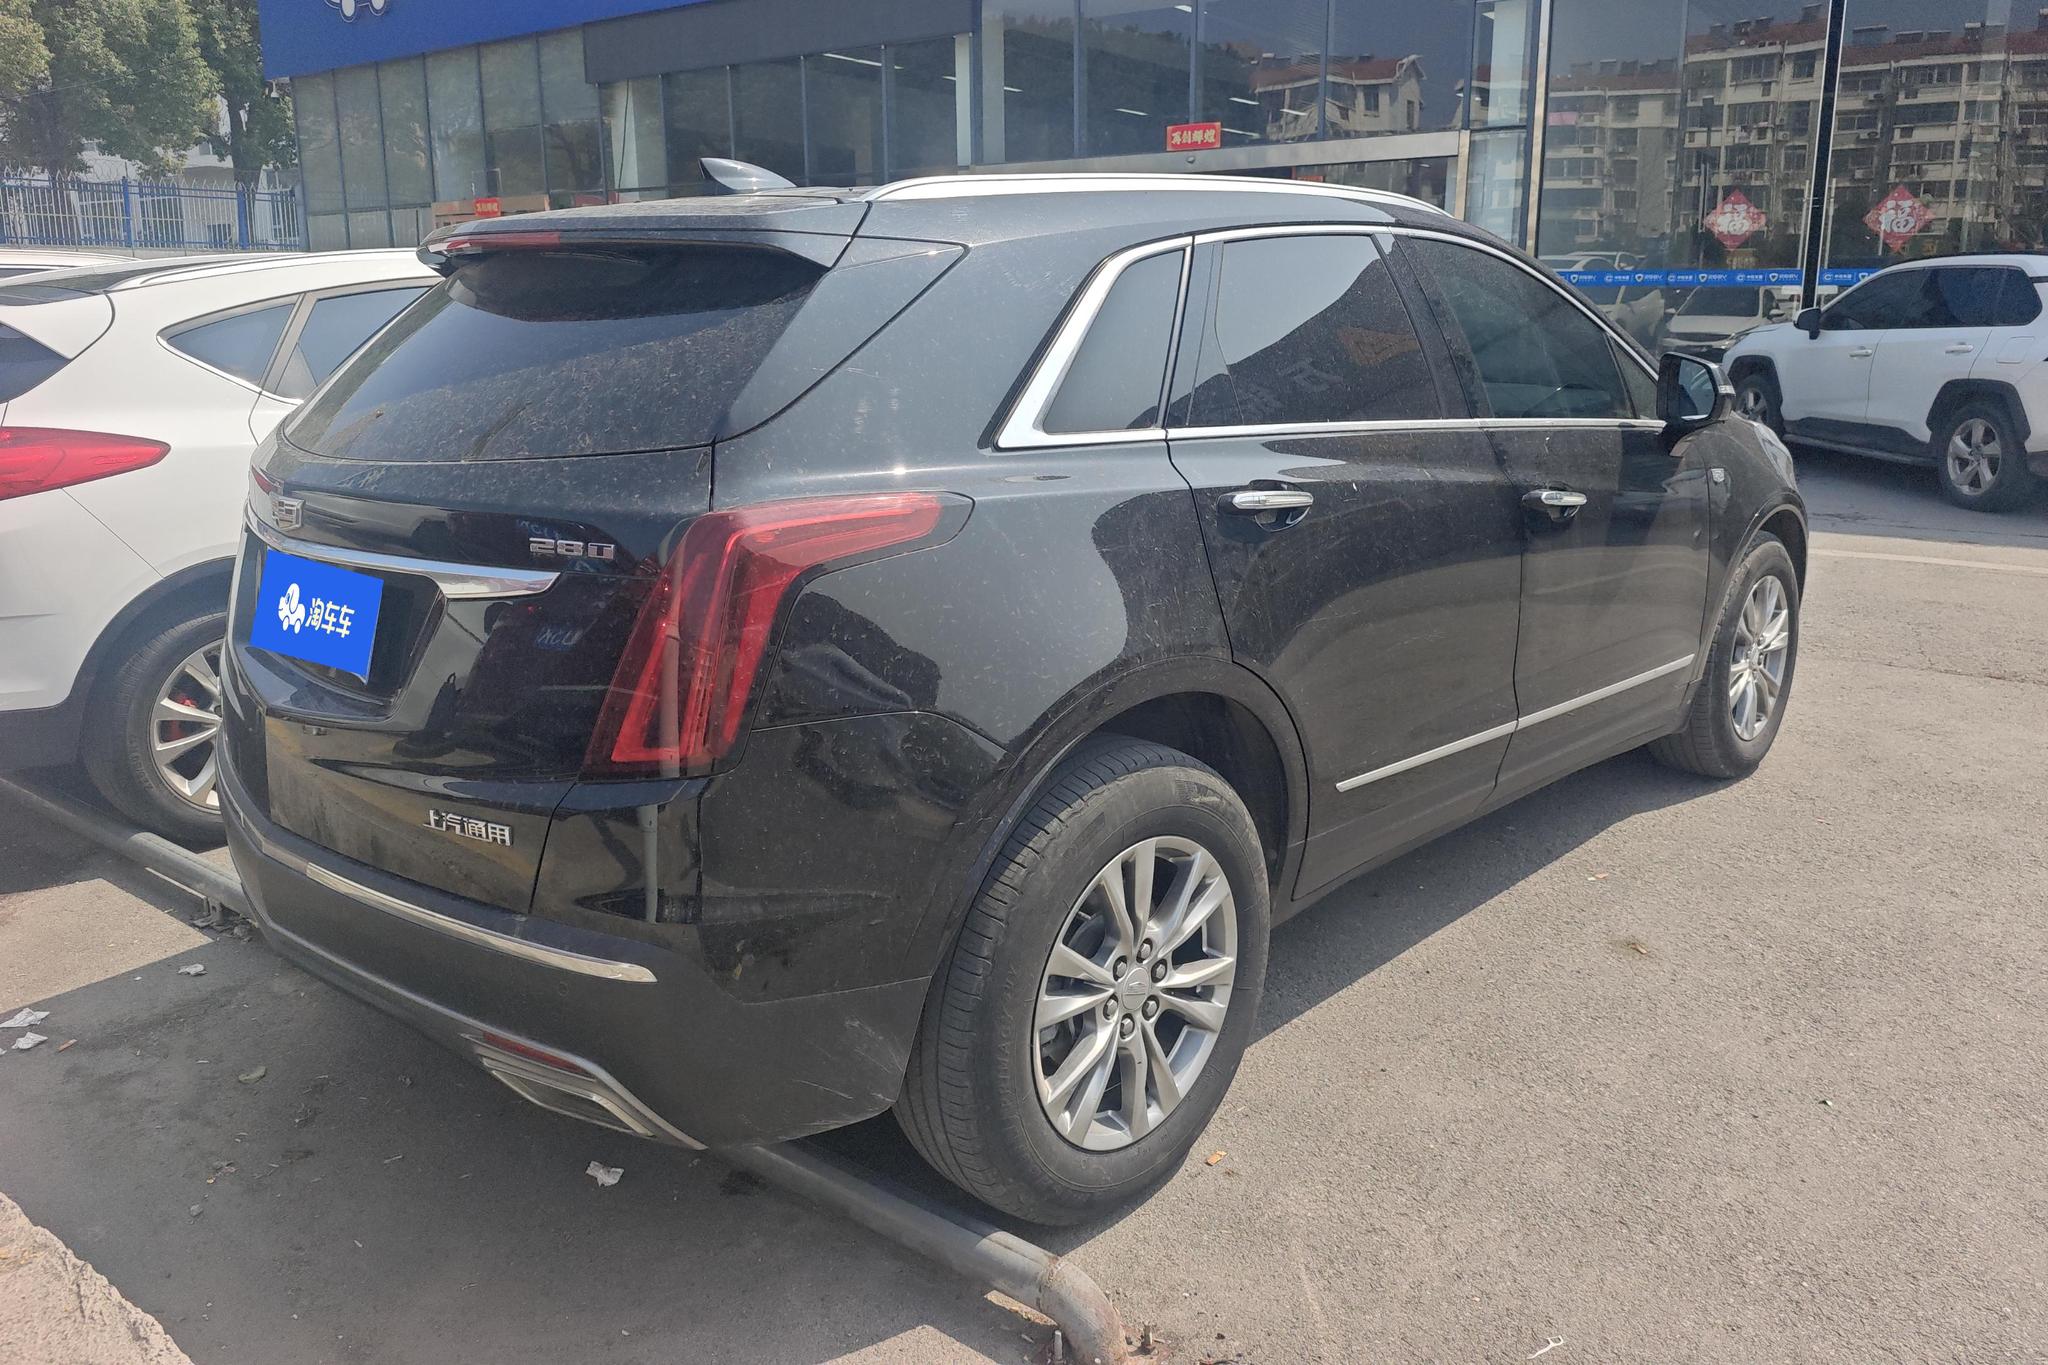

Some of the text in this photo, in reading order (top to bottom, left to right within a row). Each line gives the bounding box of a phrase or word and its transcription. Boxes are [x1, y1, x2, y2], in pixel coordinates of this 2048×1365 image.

[1717, 203, 1752, 234] 福
[1879, 199, 1915, 233] 福
[529, 537, 614, 560] 28T
[422, 809, 511, 846] 上汽通用
